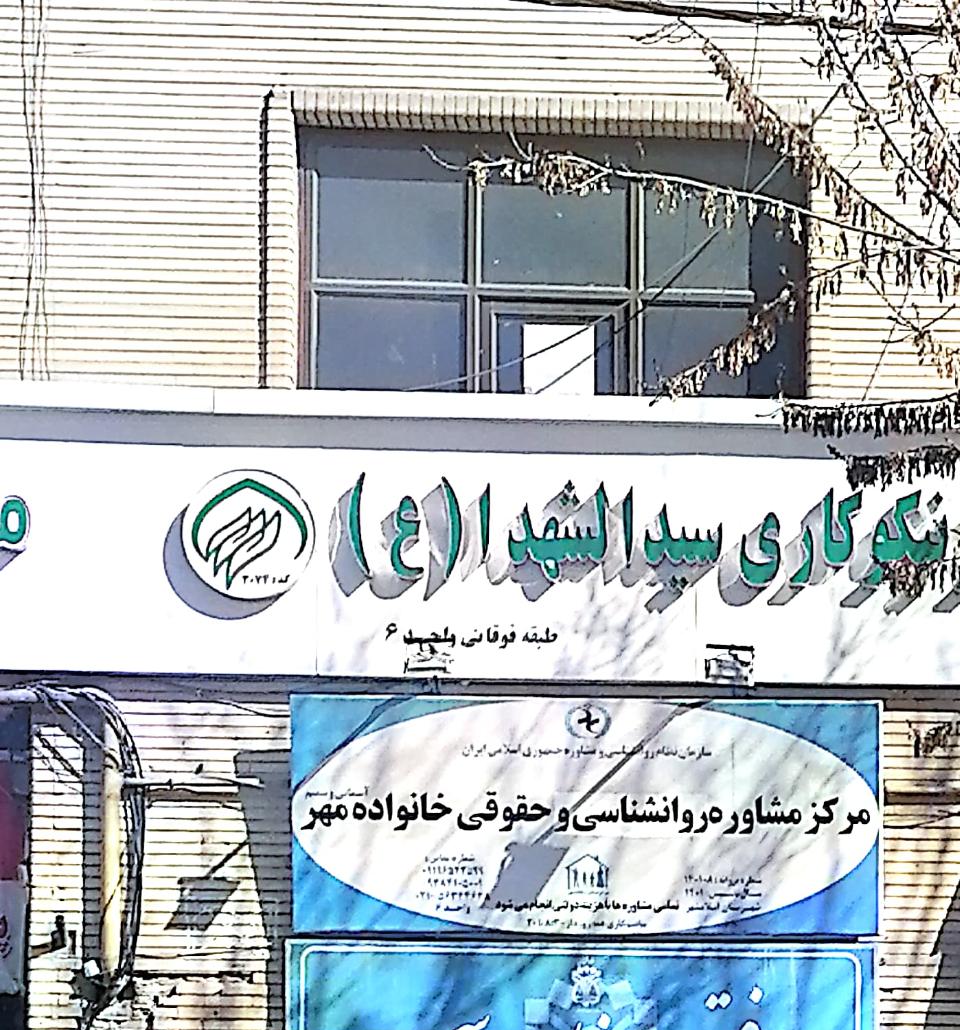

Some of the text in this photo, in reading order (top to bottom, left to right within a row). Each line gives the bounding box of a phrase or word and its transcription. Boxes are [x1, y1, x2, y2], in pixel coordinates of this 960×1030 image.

[385, 622, 558, 650] طبقه فوقانی واحد ۶
[461, 743, 487, 758] ایران
[487, 743, 522, 758] اسلامی
[300, 791, 871, 835] مرکز مشاوره روانشناسی و حقوقی خانواده مهر
